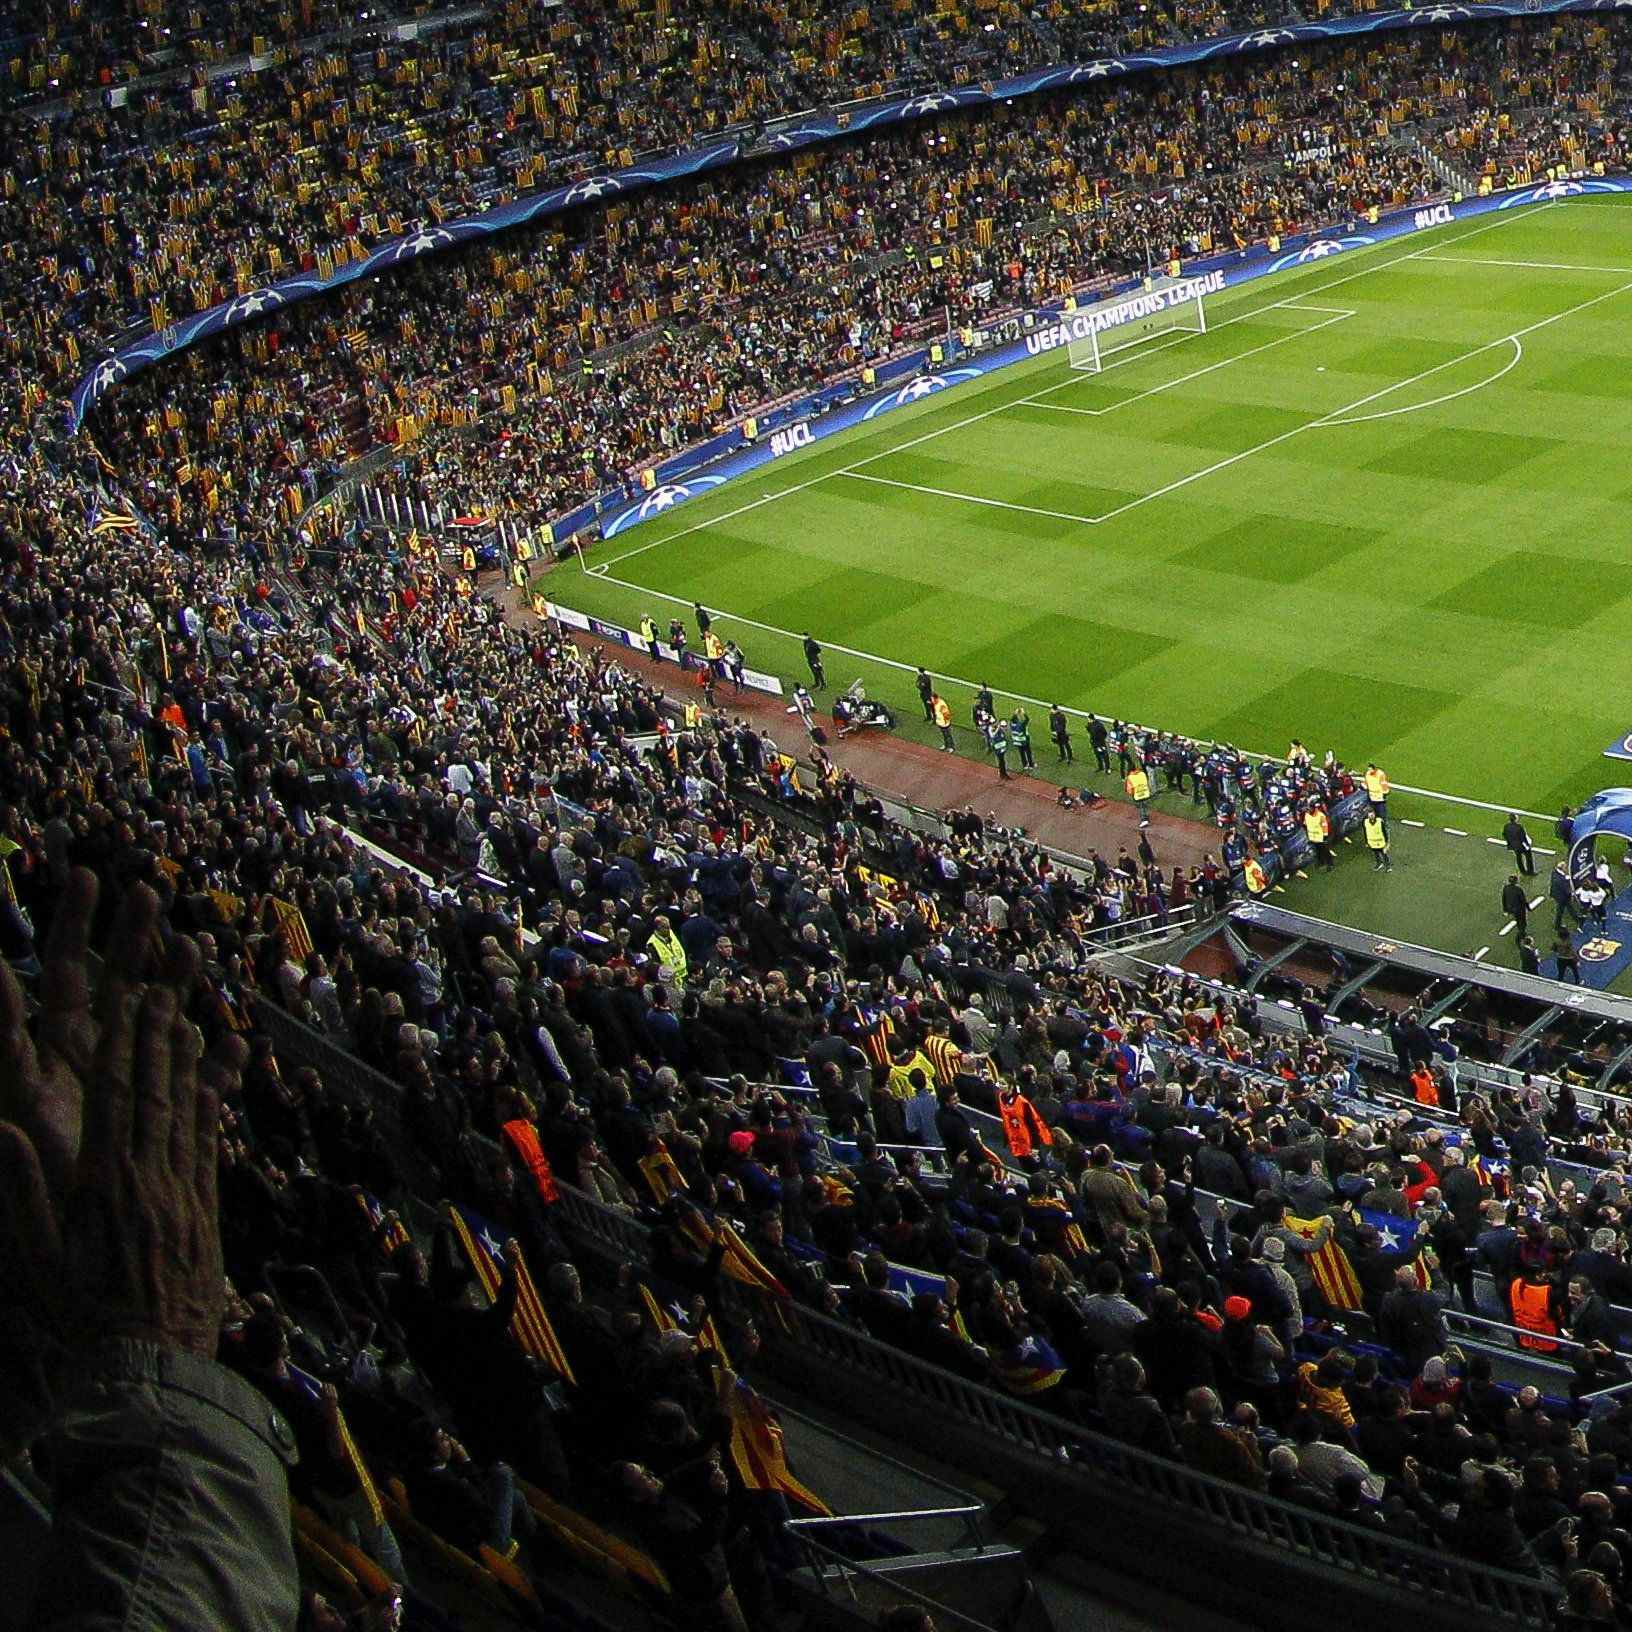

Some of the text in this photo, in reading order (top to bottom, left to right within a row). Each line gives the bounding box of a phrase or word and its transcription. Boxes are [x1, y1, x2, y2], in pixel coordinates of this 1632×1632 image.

[1415, 204, 1455, 229] #UCL
[1025, 269, 1226, 354] UEFA CHAMPIONS LEAGUE
[770, 421, 816, 457] #UCL
